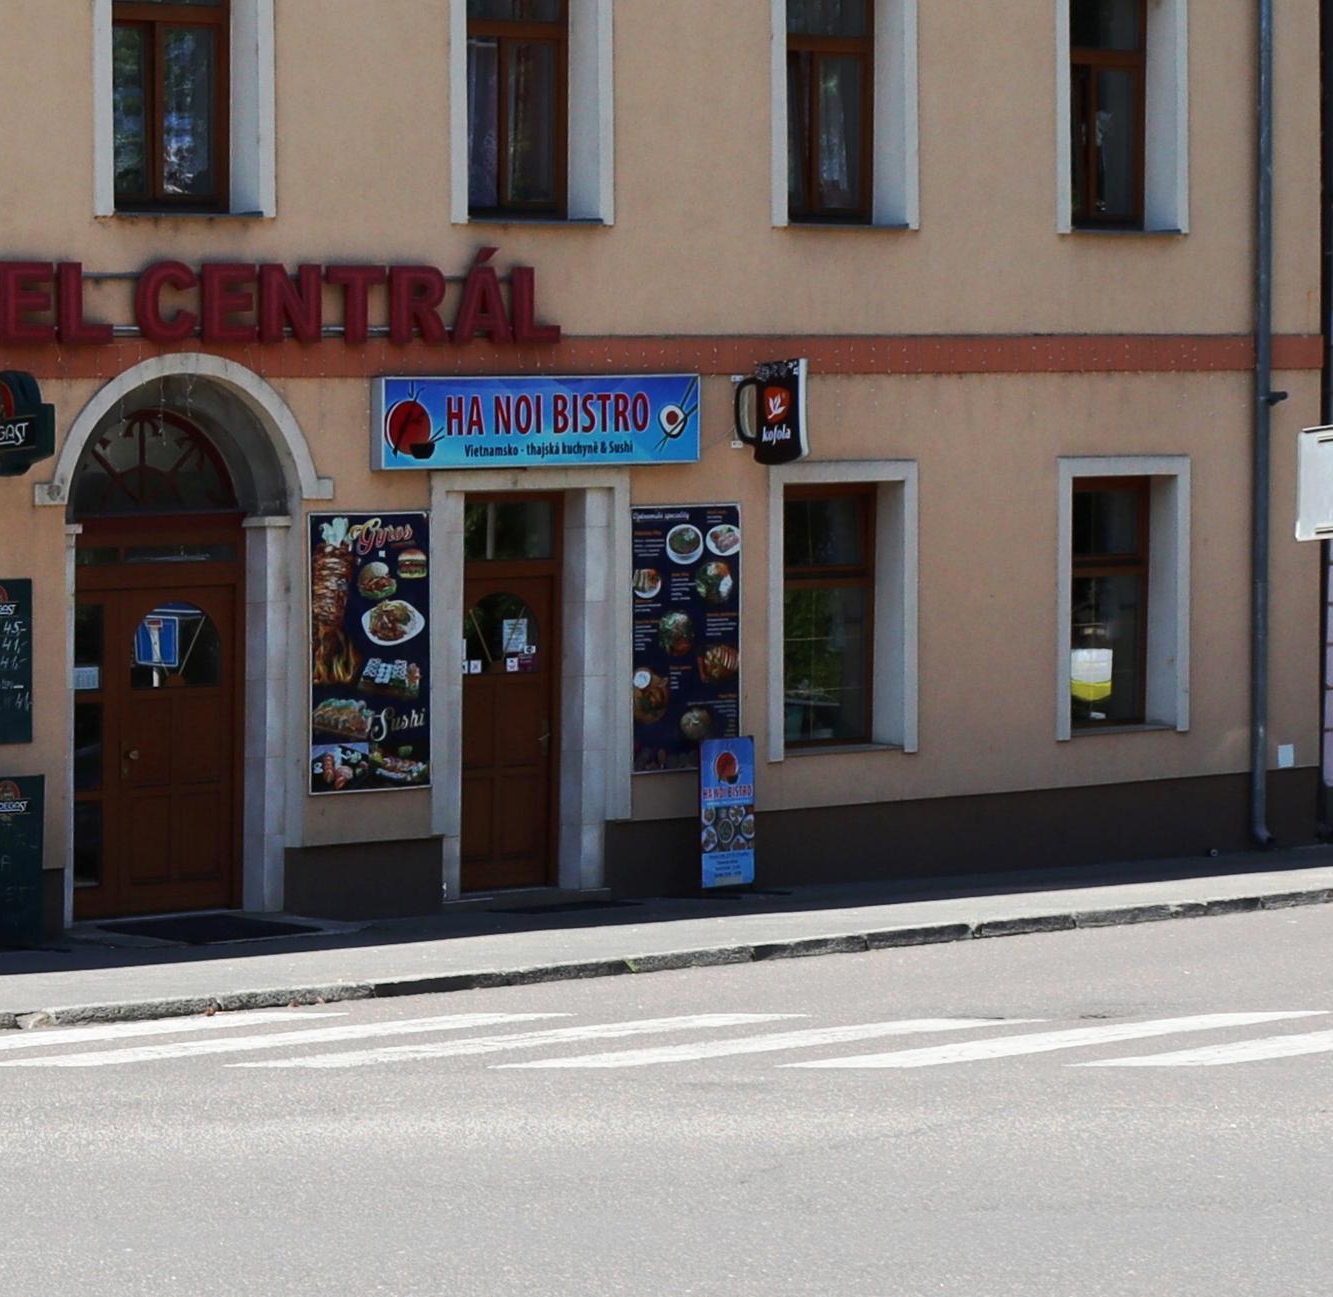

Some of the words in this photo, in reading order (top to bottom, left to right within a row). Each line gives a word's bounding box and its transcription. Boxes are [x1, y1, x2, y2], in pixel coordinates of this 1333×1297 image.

[137, 246, 561, 346] CENTRÁL
[446, 395, 485, 436] HA
[494, 393, 543, 435] NOI
[552, 391, 651, 435] BISTRO
[464, 444, 519, 457] Vietnamsko
[526, 442, 560, 458] thajská
[561, 441, 598, 457] kuchyně
[600, 441, 607, 453] &
[609, 440, 634, 453] Sushi
[762, 424, 791, 446] kofola
[349, 517, 413, 555] Gyros
[369, 707, 426, 742] Sushi
